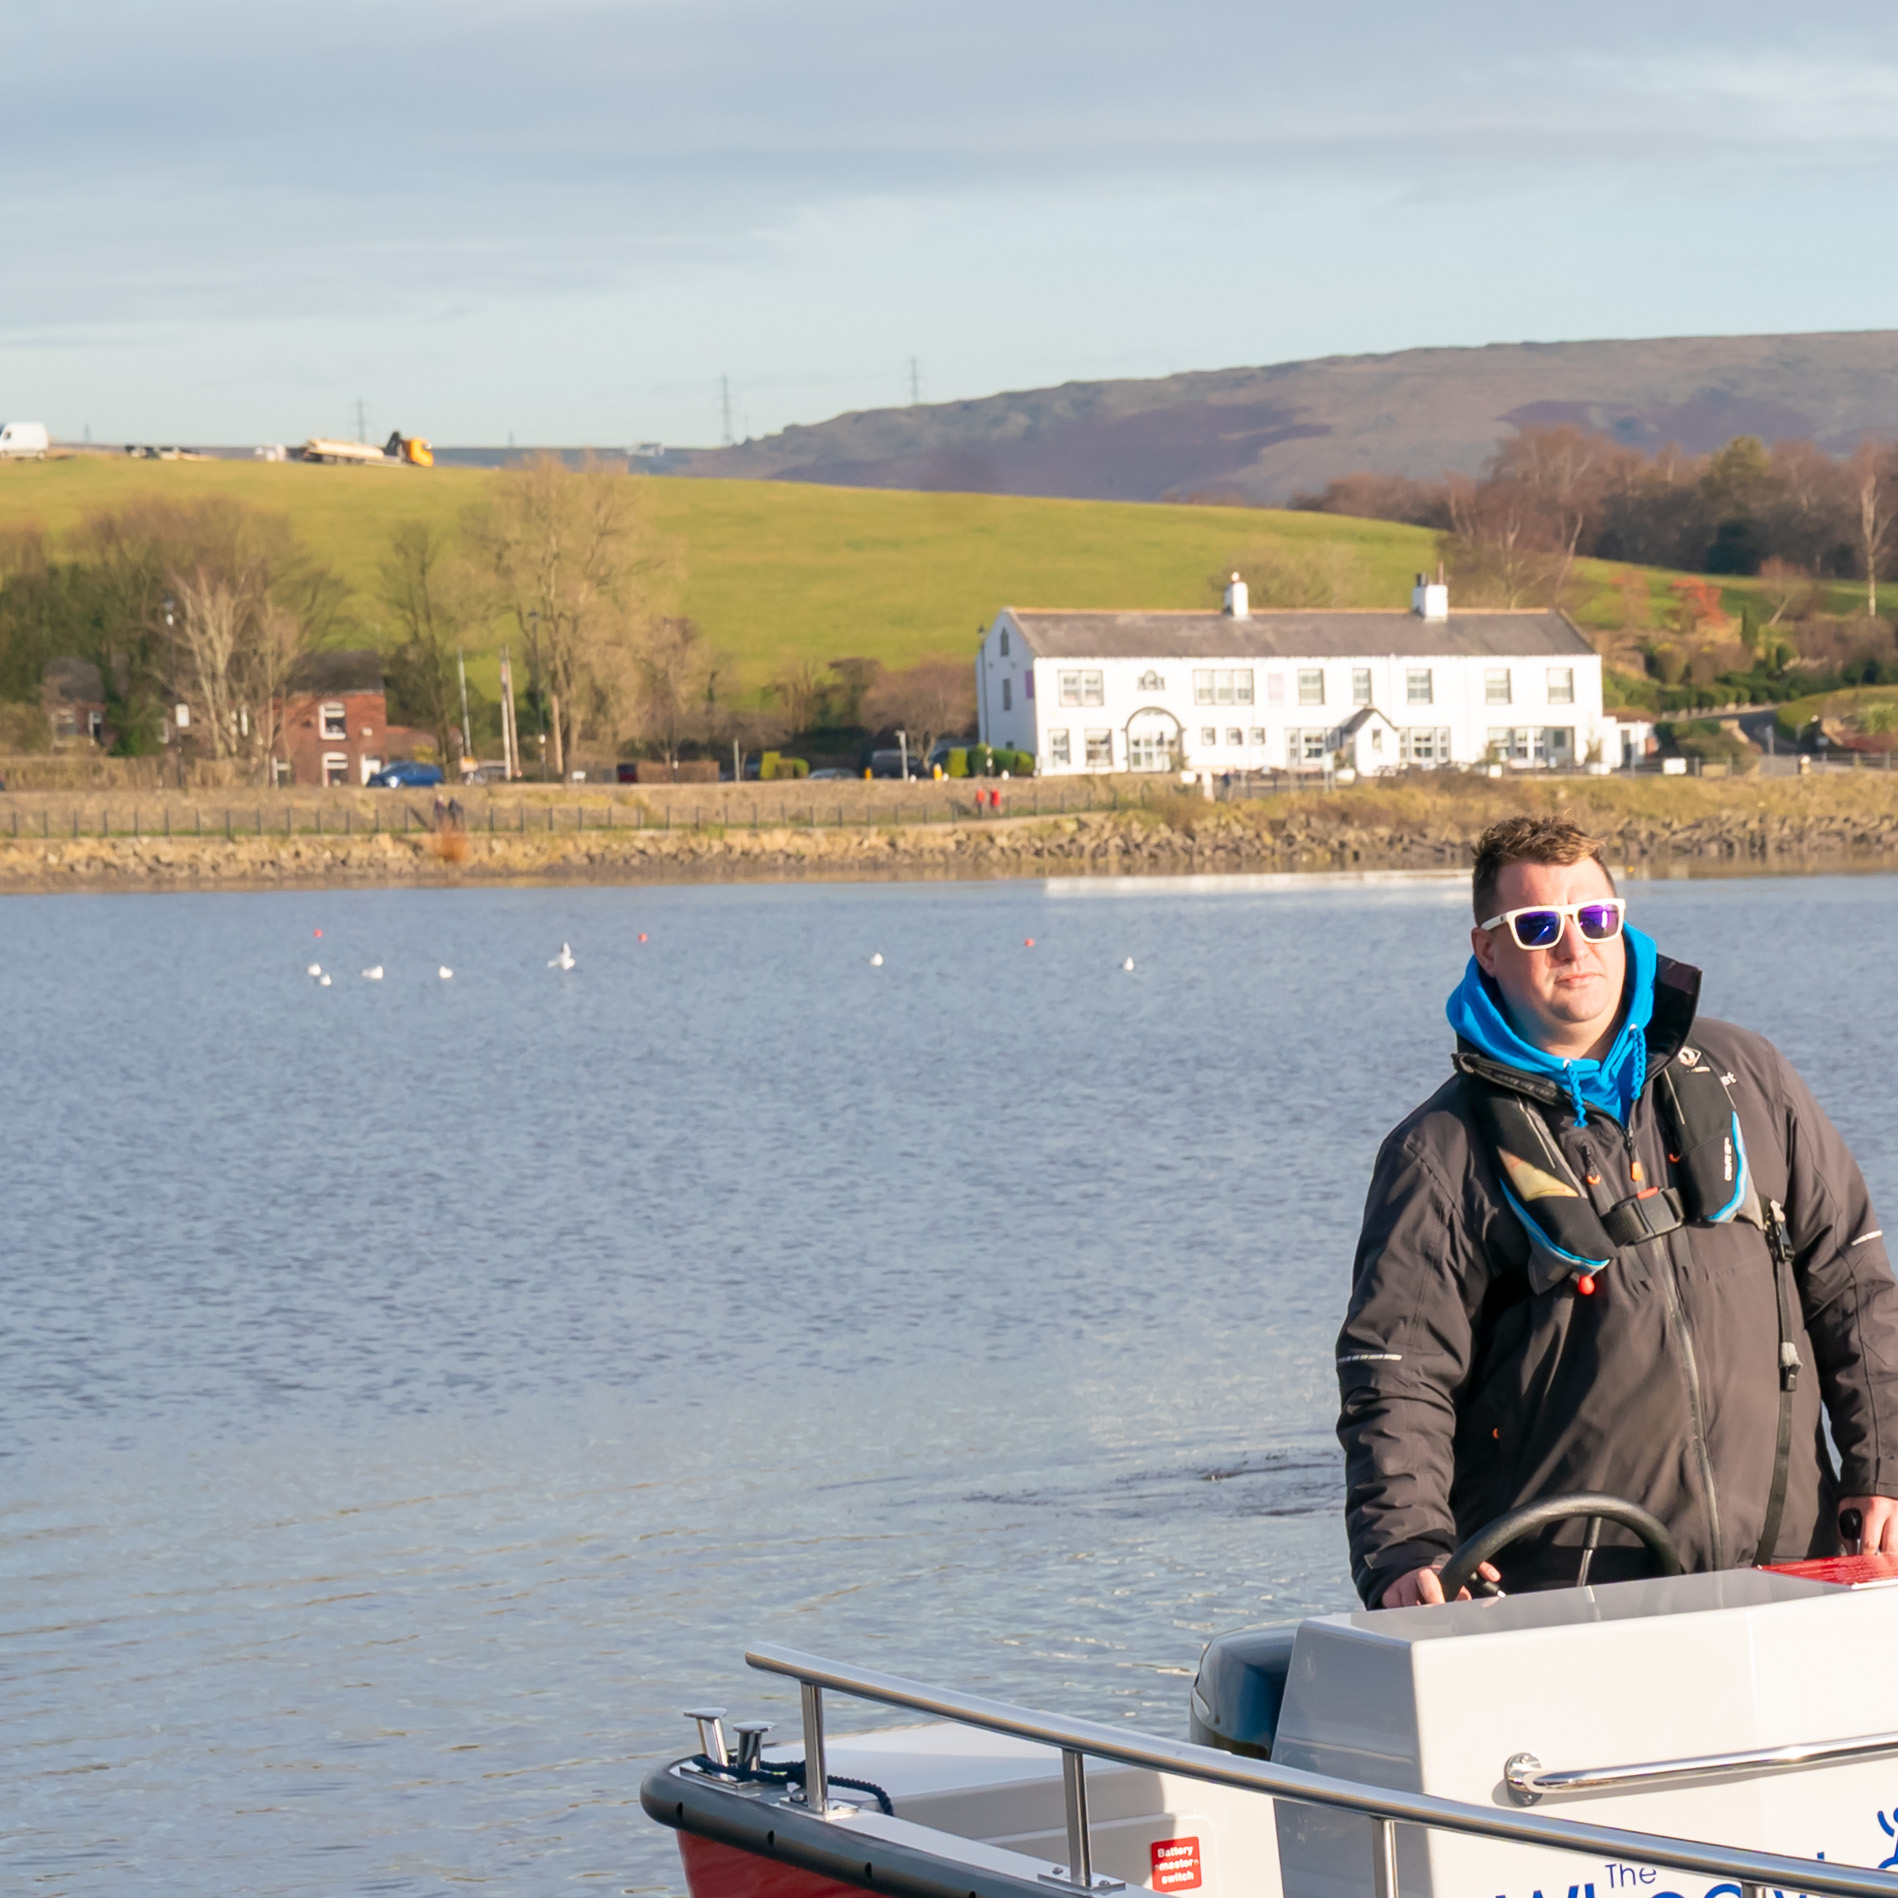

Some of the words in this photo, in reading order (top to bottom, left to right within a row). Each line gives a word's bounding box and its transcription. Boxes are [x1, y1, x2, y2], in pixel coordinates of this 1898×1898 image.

[1157, 1846, 1194, 1858] Battery
[1159, 1859, 1194, 1871] master
[1161, 1871, 1194, 1884] switch
[1605, 1864, 1657, 1888] The
